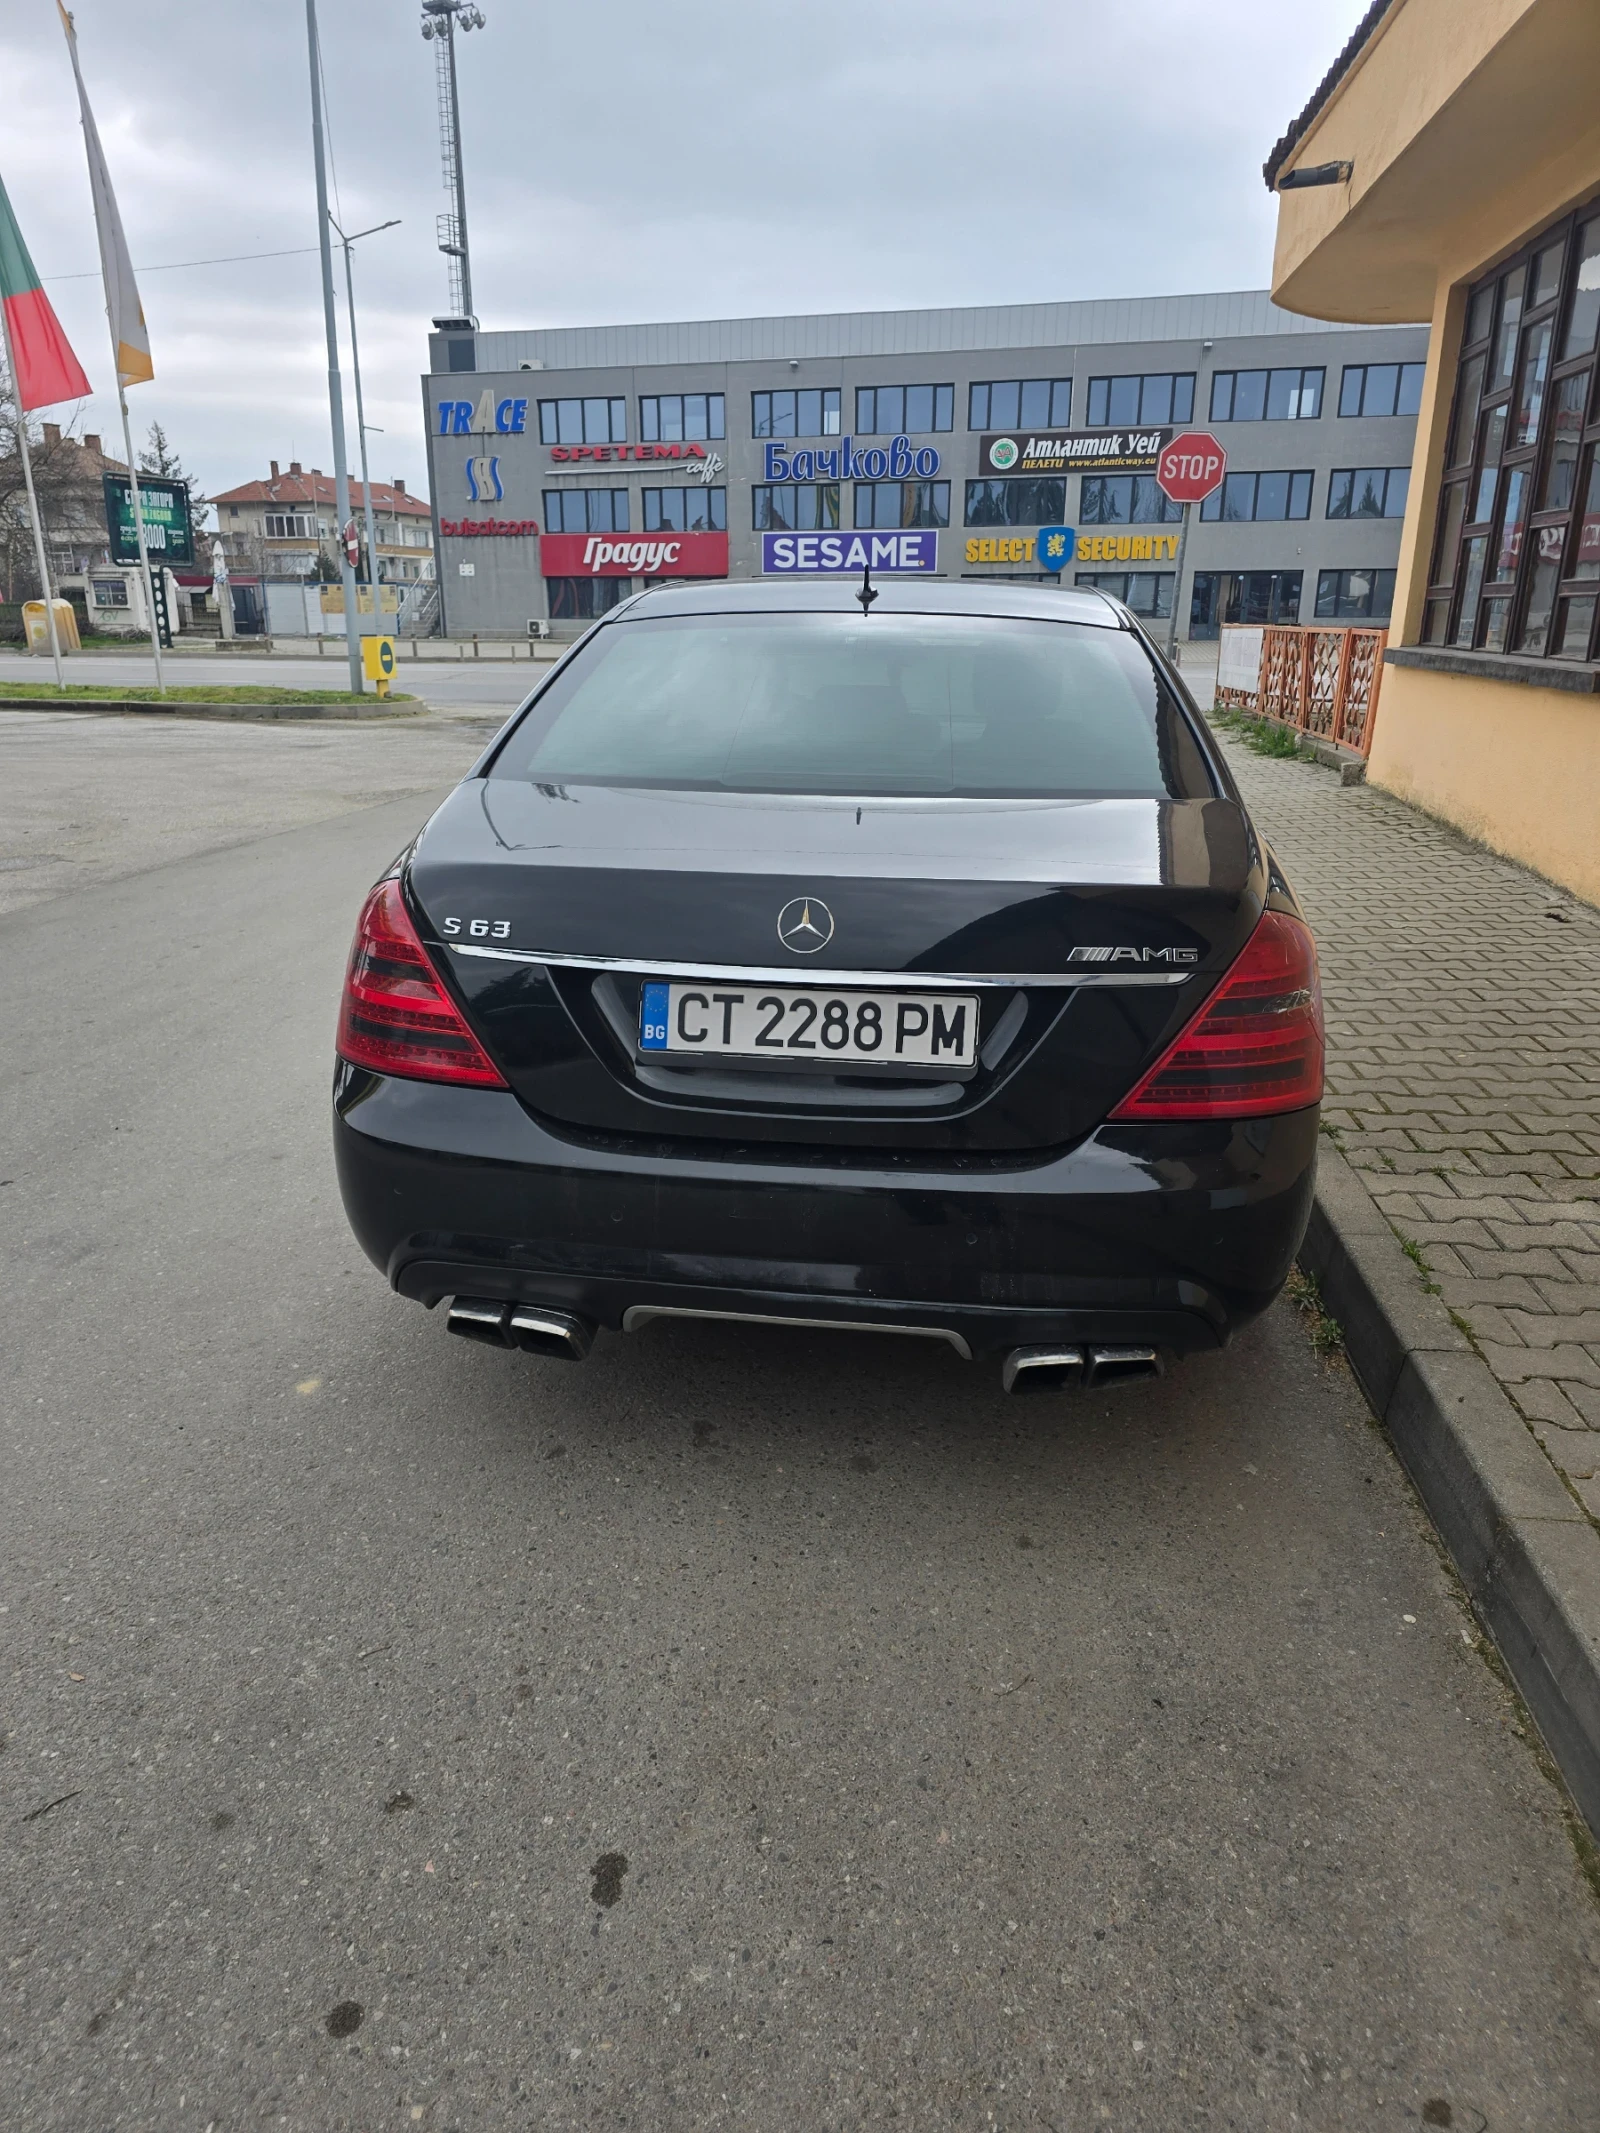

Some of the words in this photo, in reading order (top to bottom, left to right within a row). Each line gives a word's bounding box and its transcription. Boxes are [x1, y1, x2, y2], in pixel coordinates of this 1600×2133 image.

[438, 389, 529, 434] TRACE
[551, 443, 708, 462] SPETEMA
[1022, 437, 1123, 459] Атлантик
[1125, 432, 1162, 454] Уей
[763, 434, 941, 482] Бачково
[1022, 458, 1064, 469] ПЕЛЕТИ
[1068, 457, 1157, 468] www.atlanticway.eu
[1163, 454, 1219, 480] STOP
[440, 517, 538, 536] bulsatcom
[583, 537, 681, 572] Градус
[965, 538, 1036, 563] SELECT
[1077, 535, 1180, 561] SECURITY
[443, 917, 462, 935] S
[469, 919, 512, 939] 63
[1110, 947, 1199, 963] AMG
[644, 1024, 665, 1039] BG
[677, 992, 745, 1045] CT
[754, 996, 883, 1052] 2288
[895, 1002, 967, 1057] PM
